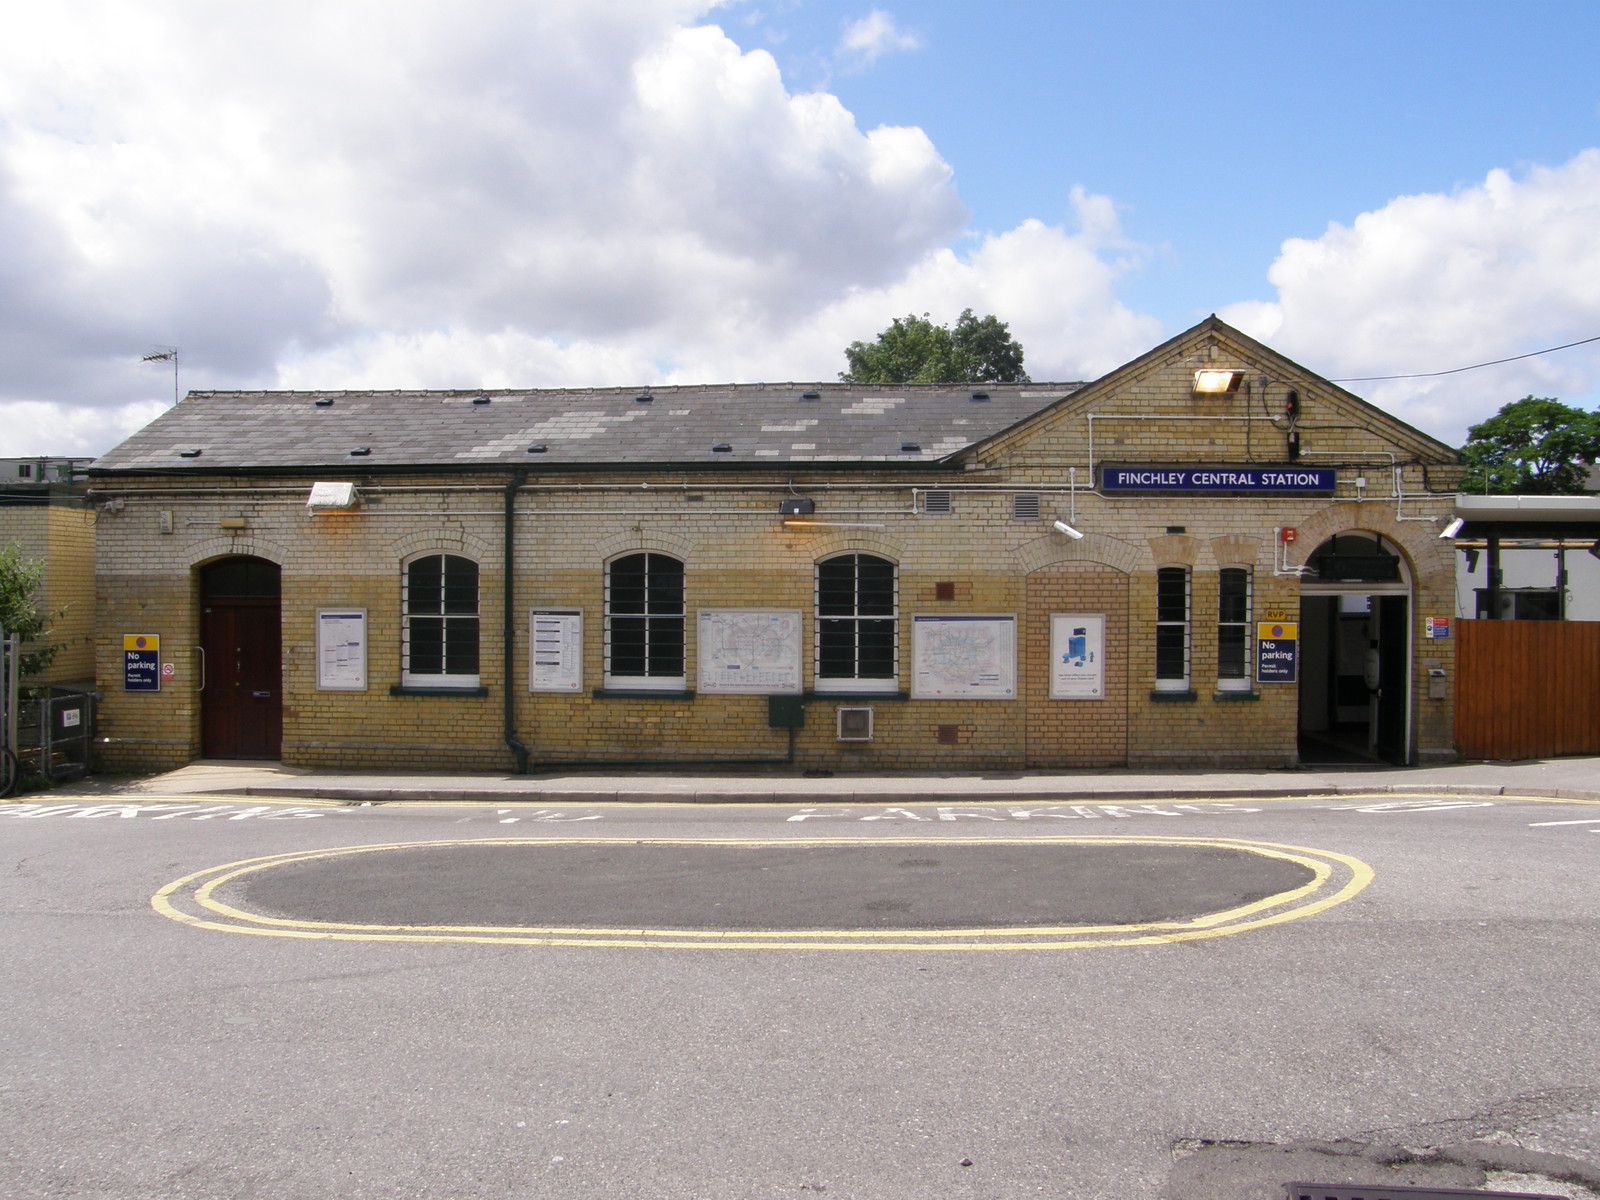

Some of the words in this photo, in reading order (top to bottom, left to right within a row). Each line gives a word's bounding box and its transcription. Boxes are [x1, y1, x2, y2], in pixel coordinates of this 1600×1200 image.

[1118, 473, 1186, 485] FINCHLEY
[1191, 473, 1255, 486] CENTRAL
[1262, 473, 1320, 486] STATION
[1262, 641, 1275, 650] No
[128, 652, 140, 660] No
[1262, 651, 1293, 661] parking
[127, 661, 156, 671] parking
[786, 803, 1263, 823] PARKING
